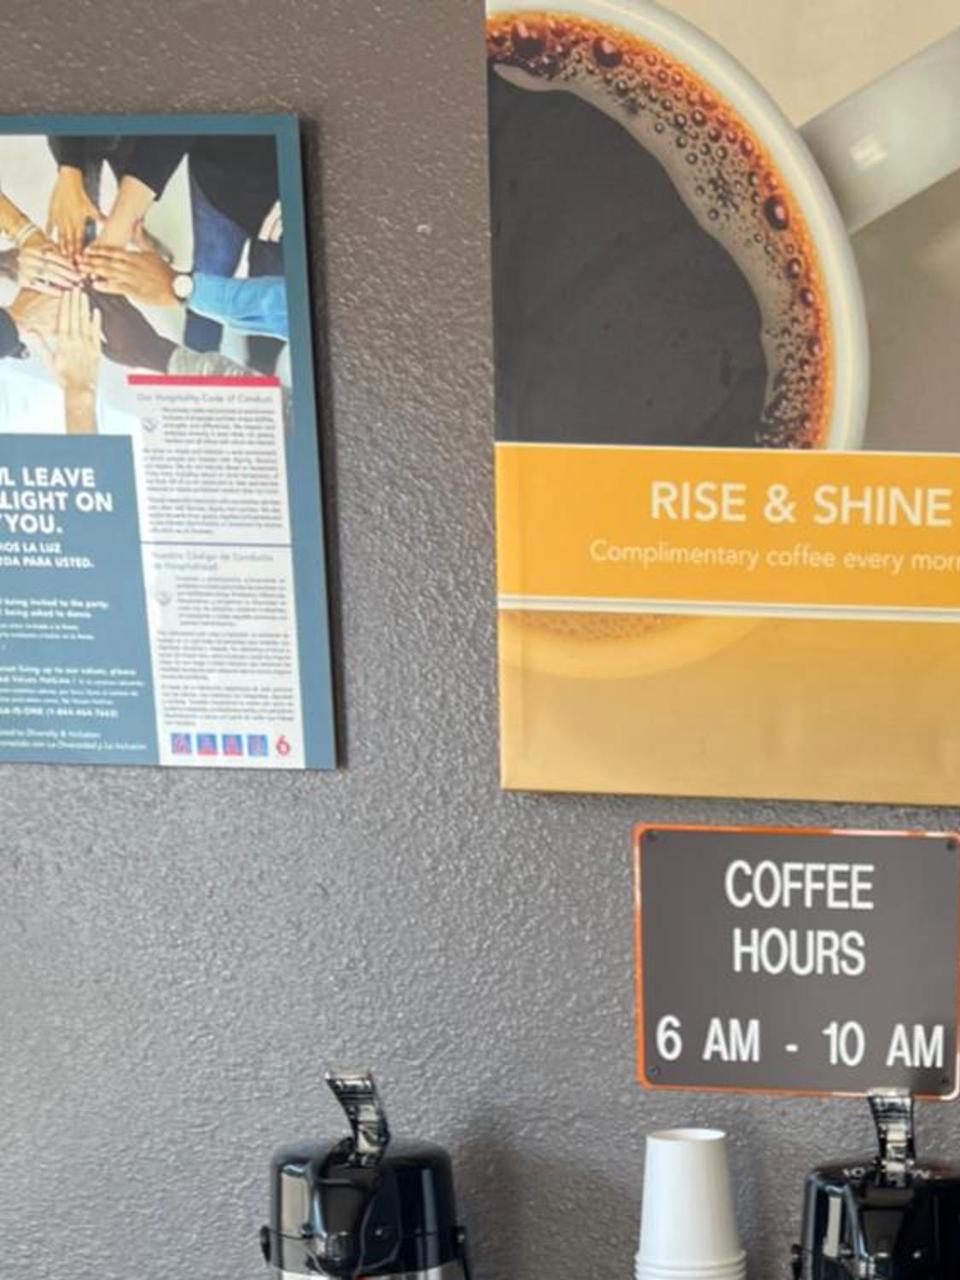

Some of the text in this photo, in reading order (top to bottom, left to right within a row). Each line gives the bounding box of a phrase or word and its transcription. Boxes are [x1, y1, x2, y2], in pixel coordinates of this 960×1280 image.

[22, 467, 96, 488] LEAVE
[0, 491, 113, 512] LIGHT ON
[650, 480, 953, 528] RISE & SHINE
[4, 513, 63, 534] YOU.
[589, 538, 760, 571] Complimentary
[766, 543, 836, 568] coffee
[843, 552, 905, 577] every
[275, 735, 291, 756] 6
[724, 859, 875, 910] COFFEE
[733, 927, 867, 976] HOURS
[656, 1015, 944, 1068] 6 AM - 10 AM
